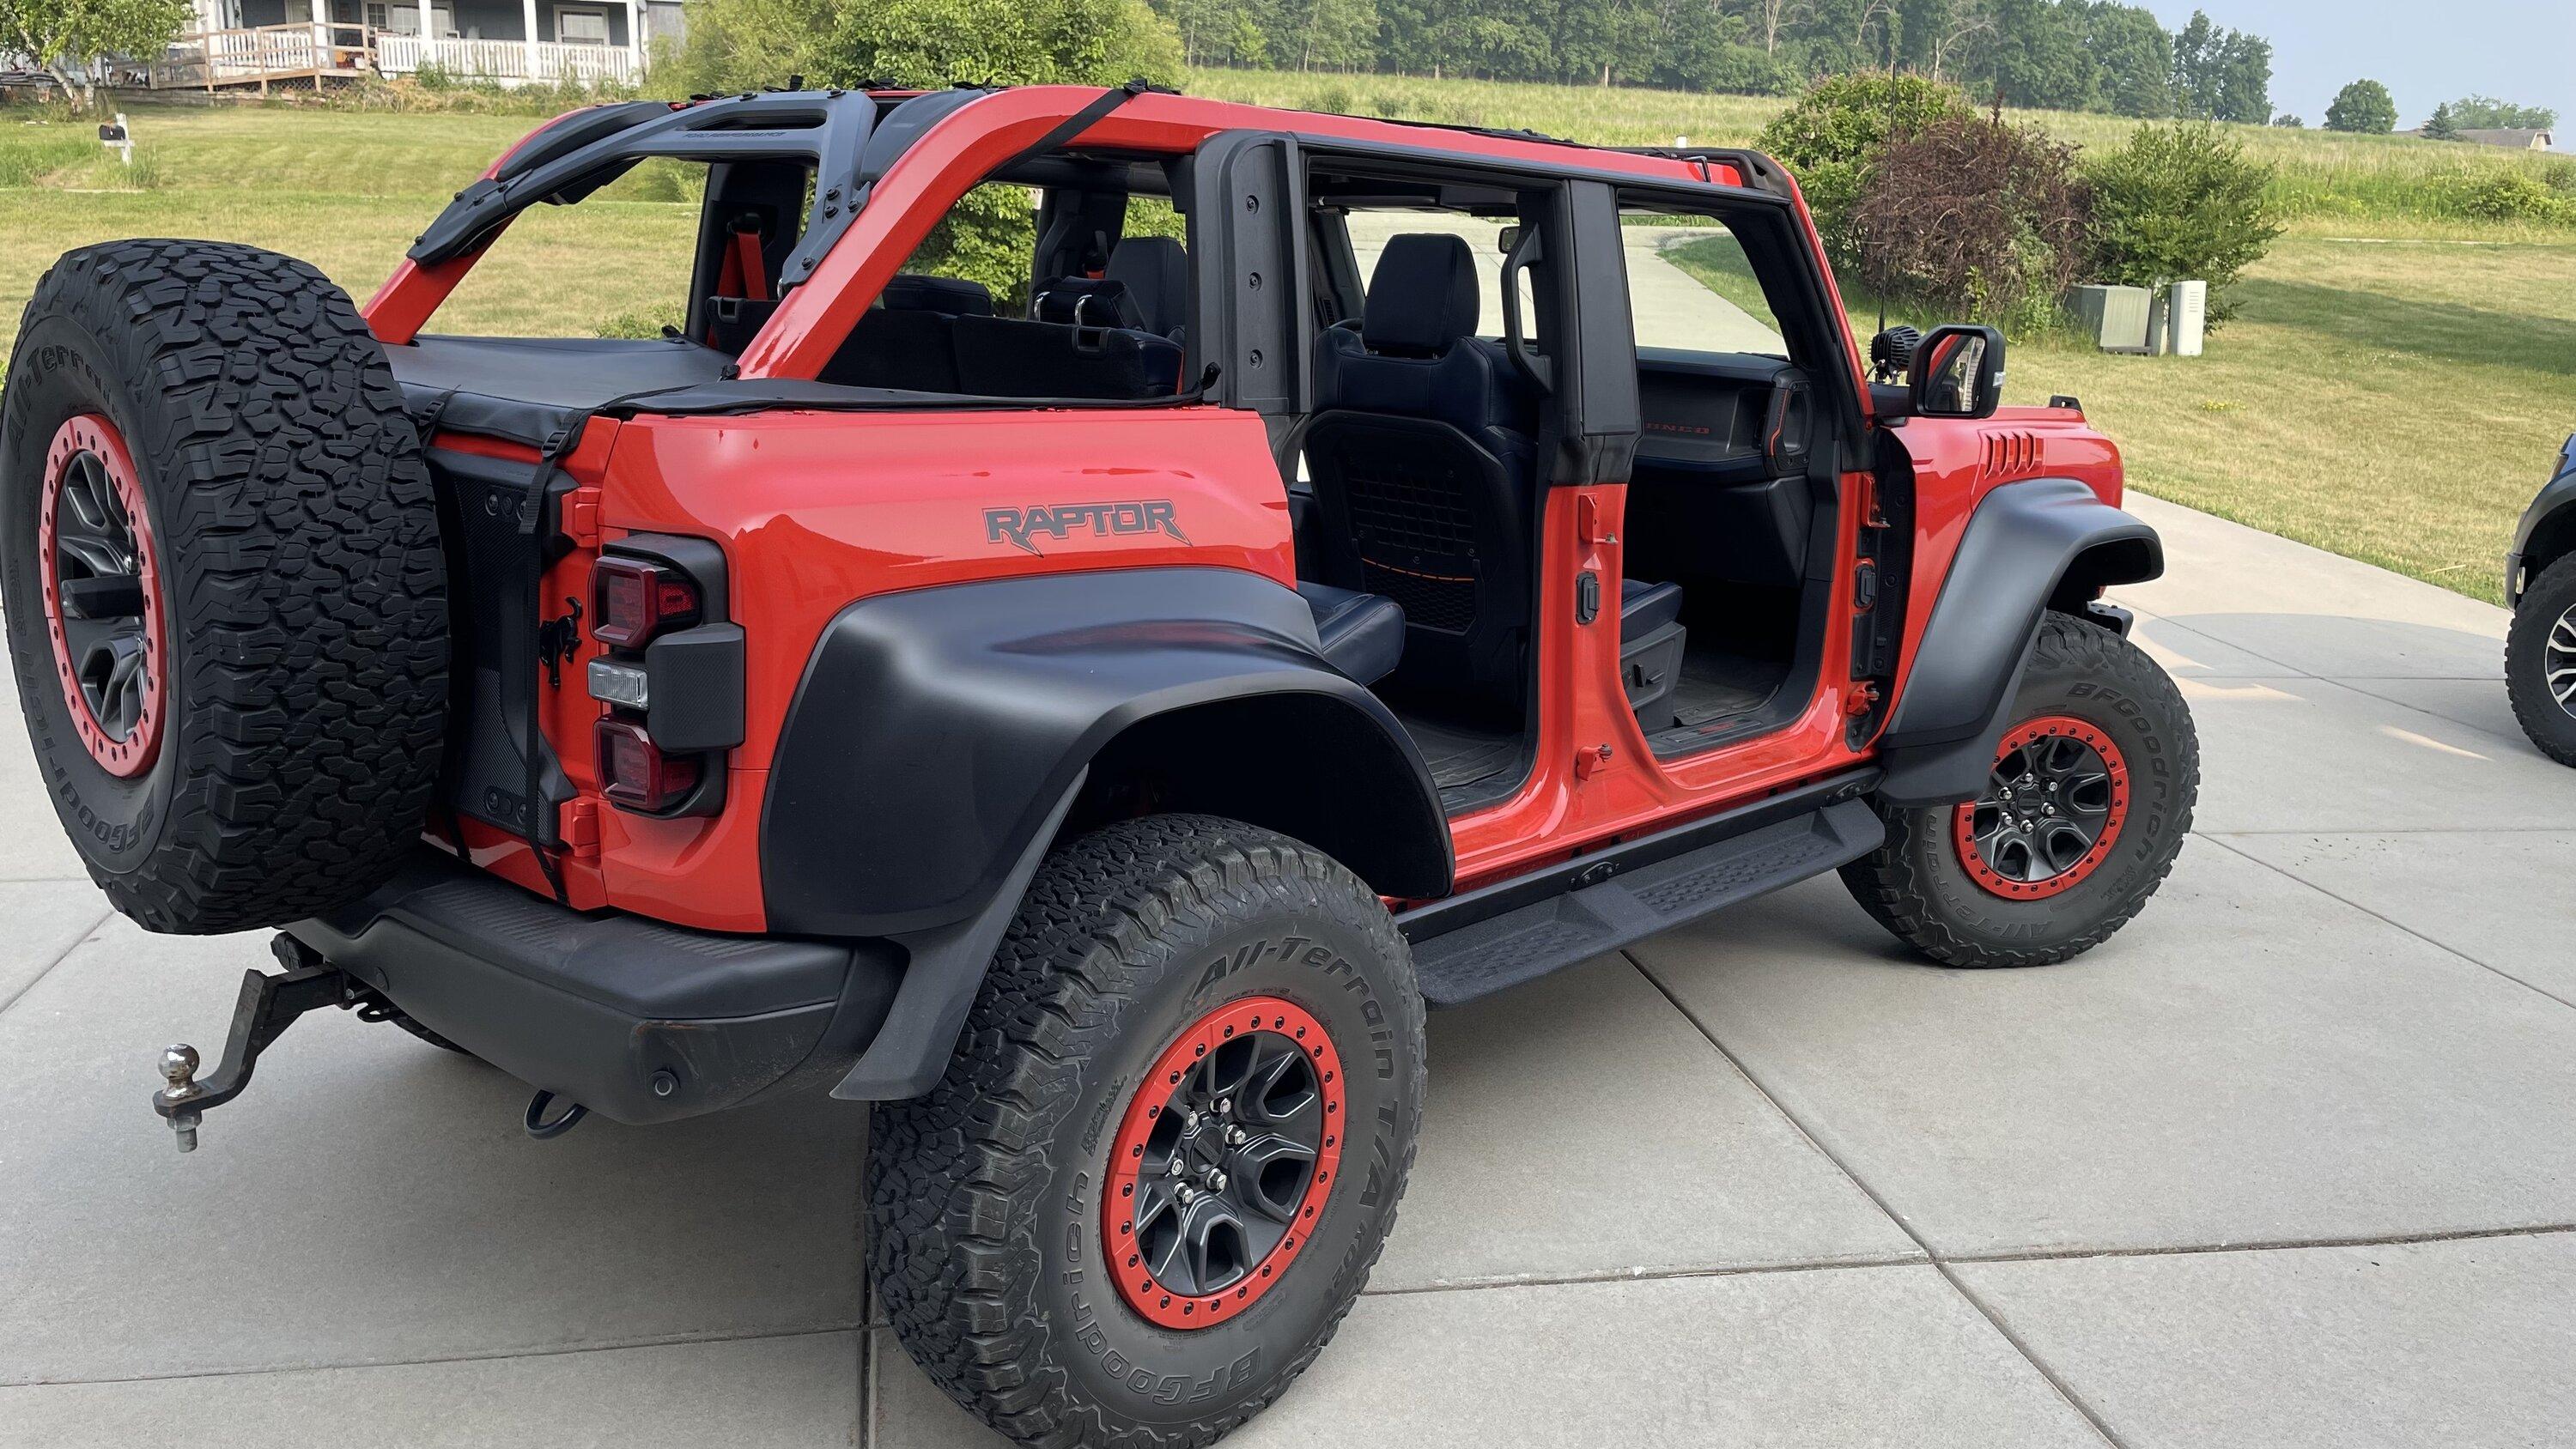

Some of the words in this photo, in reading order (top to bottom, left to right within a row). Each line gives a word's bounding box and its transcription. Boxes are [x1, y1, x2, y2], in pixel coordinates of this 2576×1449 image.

[7, 344, 127, 465] All-Terrain
[982, 499, 1194, 558] RAPTOR
[2065, 682, 2170, 863] BFGoodrich
[1922, 814, 2055, 940] All-Terrain
[1189, 937, 1395, 1081] All-Terrain
[1357, 1099, 1400, 1209] T/A
[1062, 1171, 1264, 1406] BFGoodrich
